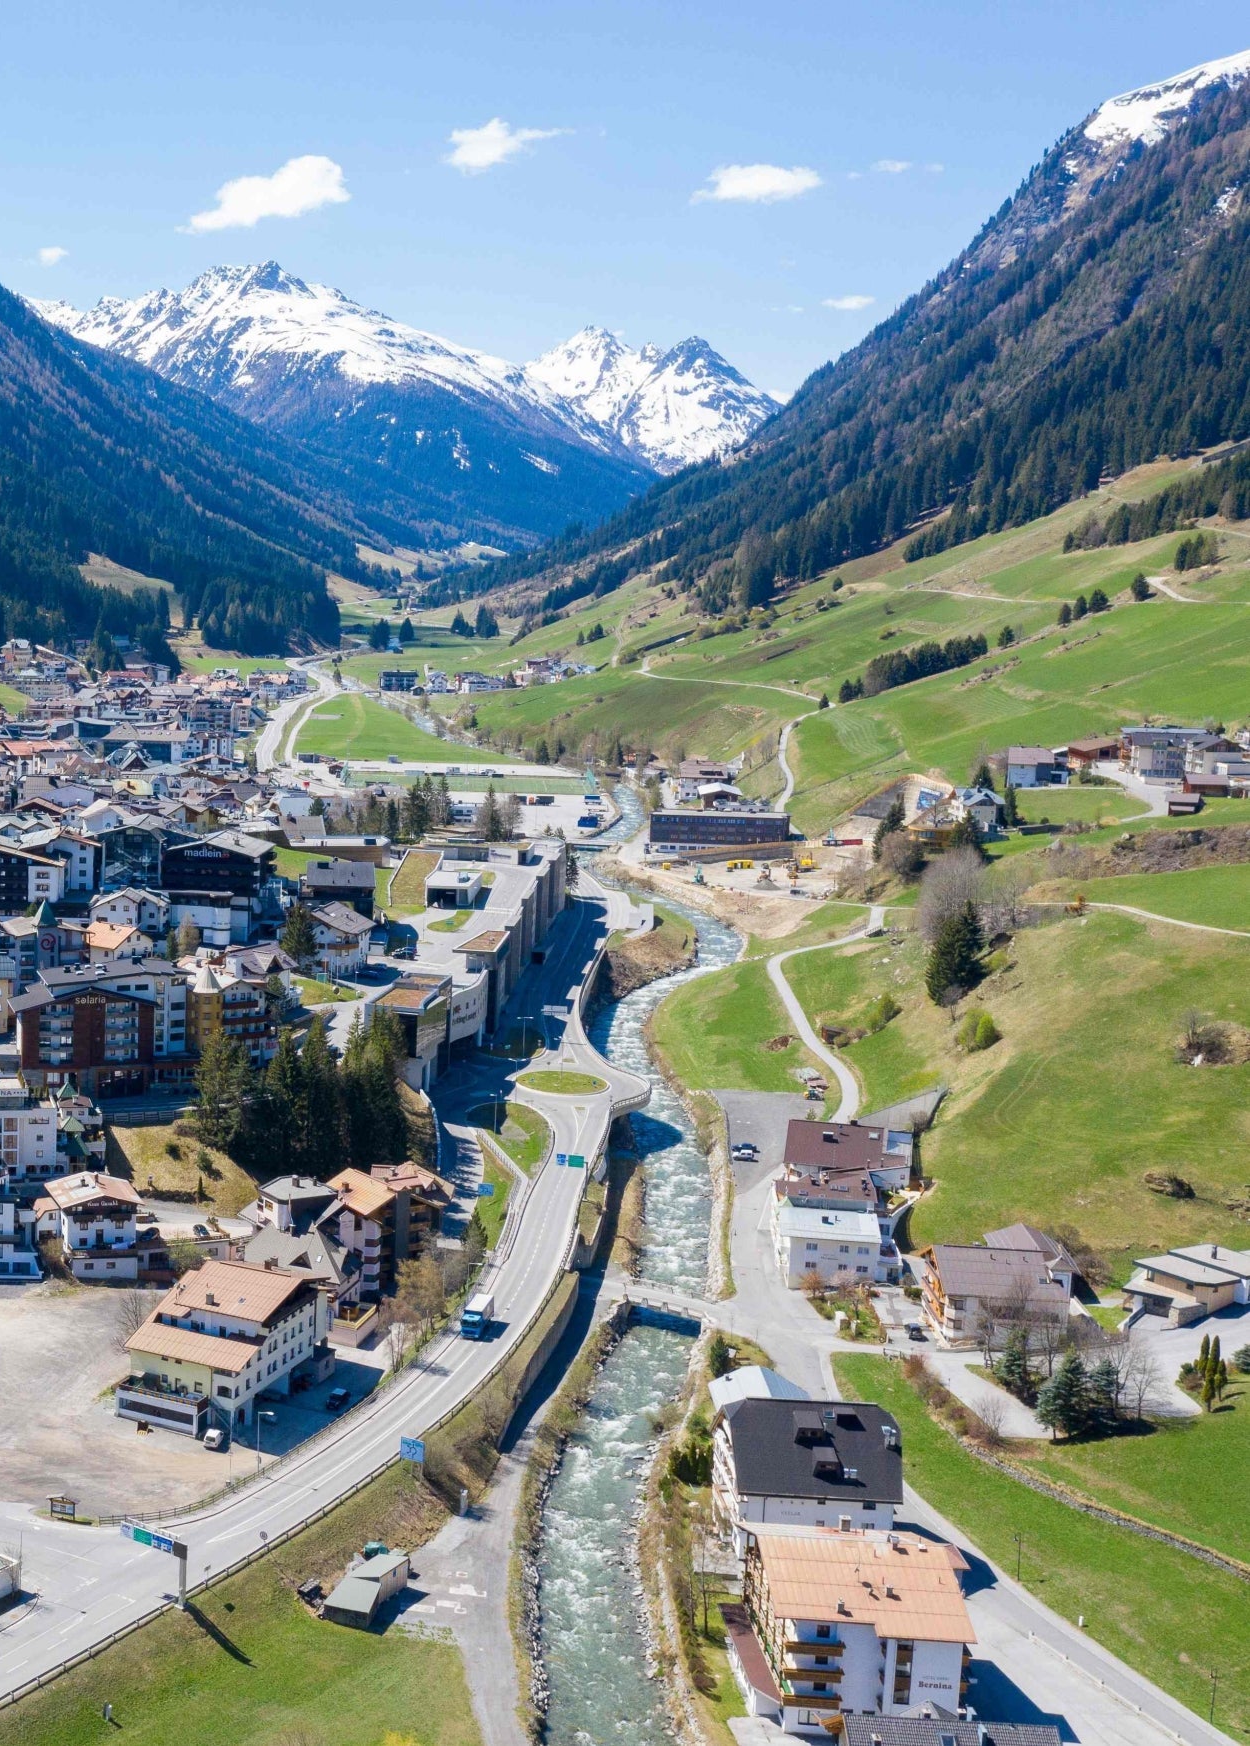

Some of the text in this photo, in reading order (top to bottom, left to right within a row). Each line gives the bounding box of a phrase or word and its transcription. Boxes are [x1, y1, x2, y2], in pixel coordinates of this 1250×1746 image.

[184, 848, 221, 857] madlein
[75, 995, 106, 1004] solaria
[918, 1680, 953, 1689] Bernina
